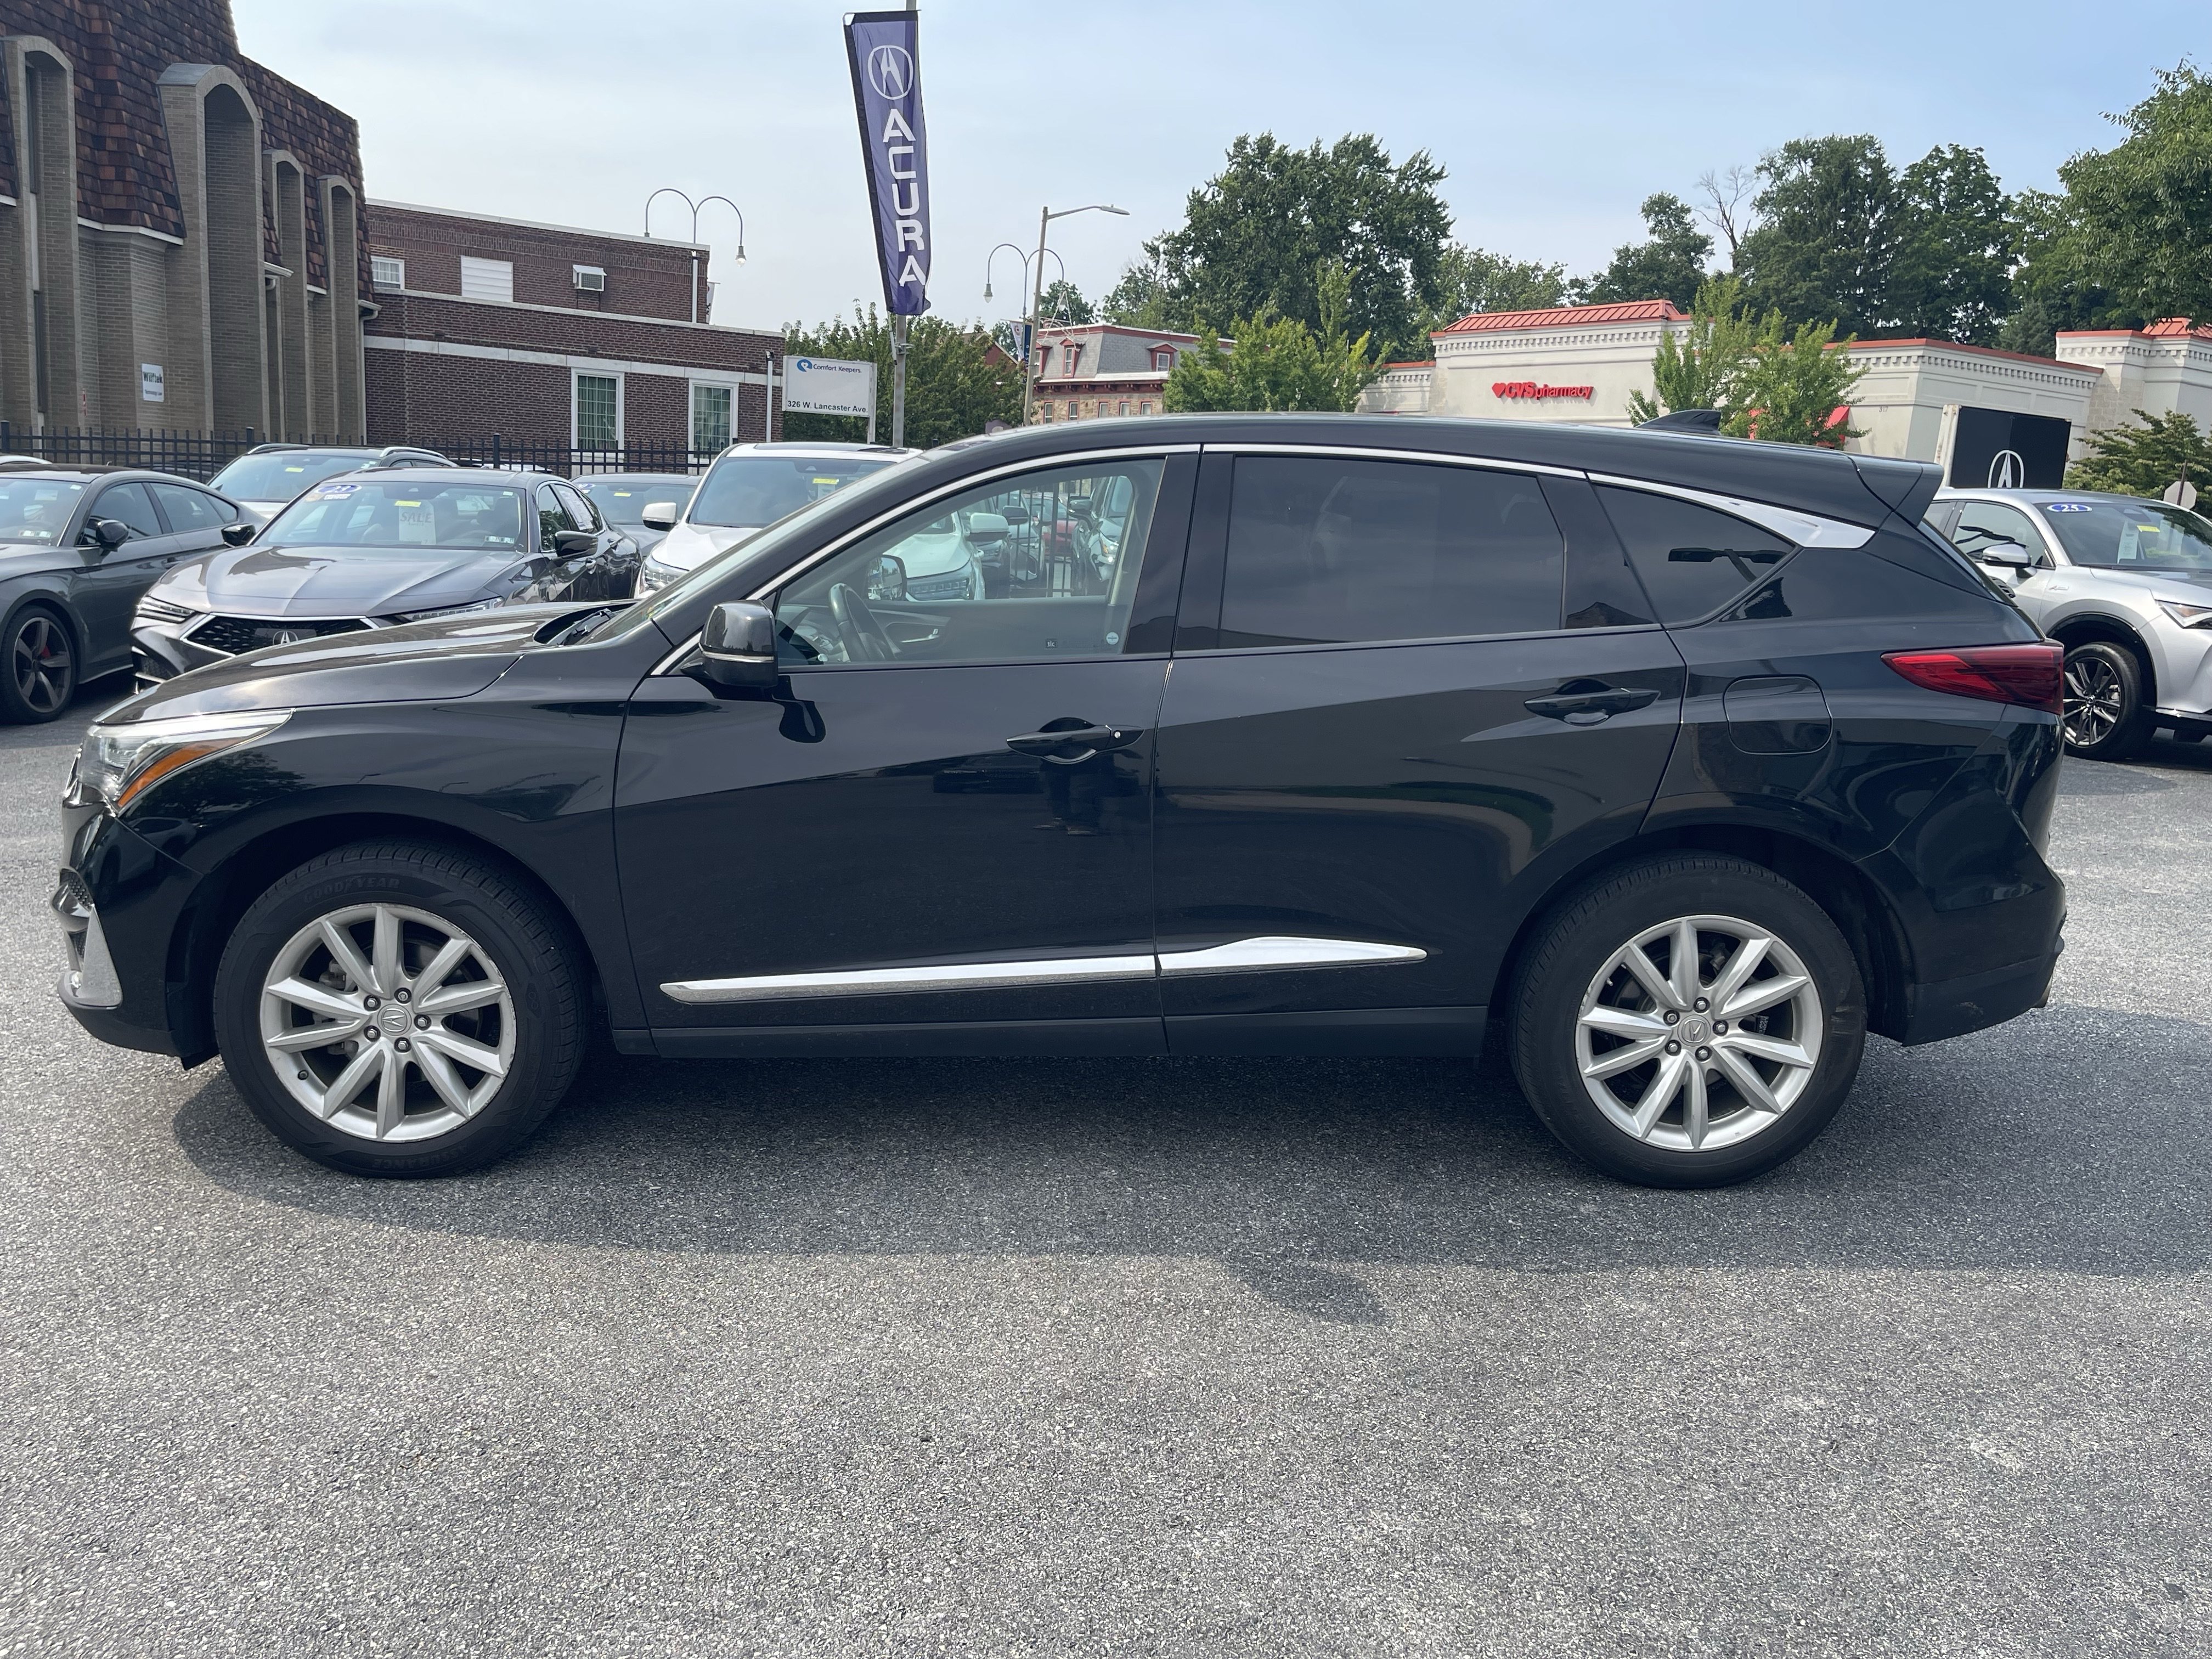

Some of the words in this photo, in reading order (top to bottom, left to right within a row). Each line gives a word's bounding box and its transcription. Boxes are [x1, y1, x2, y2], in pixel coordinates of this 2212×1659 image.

[882, 108, 926, 287] ACURA
[814, 402, 851, 411] Lancaster
[400, 511, 433, 523] SALE
[304, 876, 400, 903] GOODYEAR
